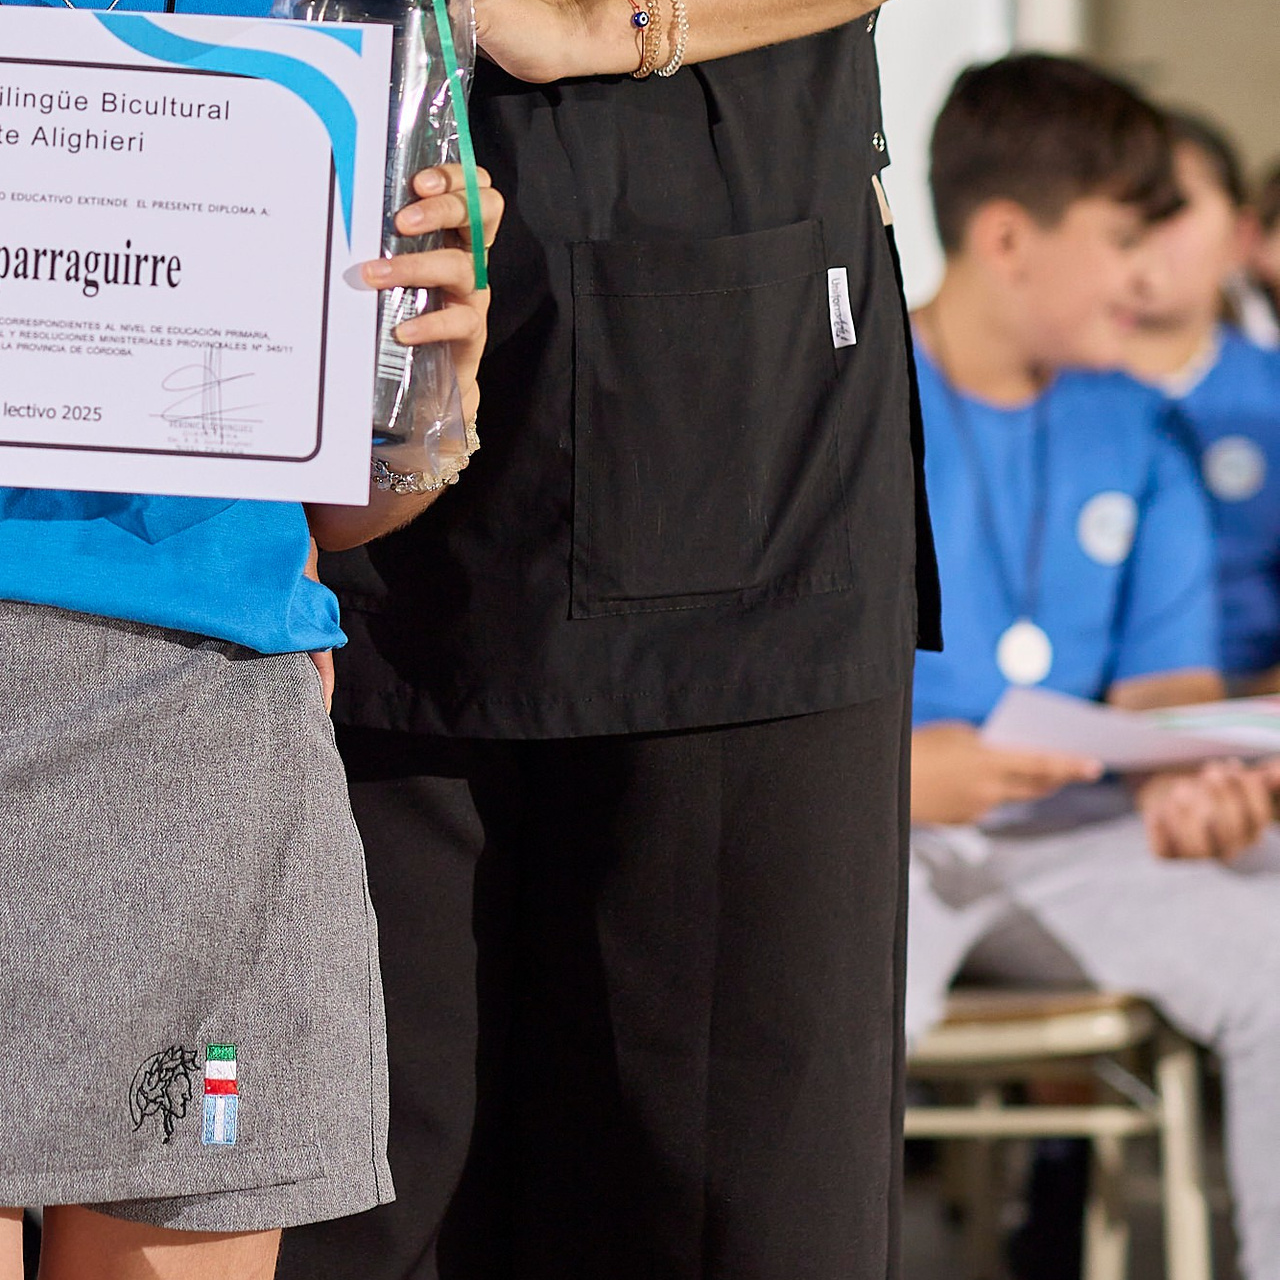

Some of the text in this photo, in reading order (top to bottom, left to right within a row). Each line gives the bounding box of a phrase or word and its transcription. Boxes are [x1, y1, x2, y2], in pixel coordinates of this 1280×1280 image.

[101, 92, 229, 120] Bicultural
[31, 126, 144, 154] Alighieri
[10, 191, 73, 205] EDUCATIVO
[77, 195, 128, 208] EXTIENDE
[136, 199, 147, 209] EL
[151, 200, 203, 213] PRESENTE
[207, 203, 256, 215] DIPLOMA
[19, 330, 95, 343] RESOLUCIONES
[99, 334, 173, 347] MINISTERIALES
[104, 323, 116, 332] AL
[120, 323, 146, 334] NIVEL
[150, 324, 163, 334] DE
[166, 325, 222, 337] EDUCACIÓN
[0, 342, 13, 351] LA
[15, 342, 66, 353] PROVINCIA
[69, 345, 83, 354] DE
[3, 402, 56, 419] lectivo
[62, 405, 102, 422] 2025
